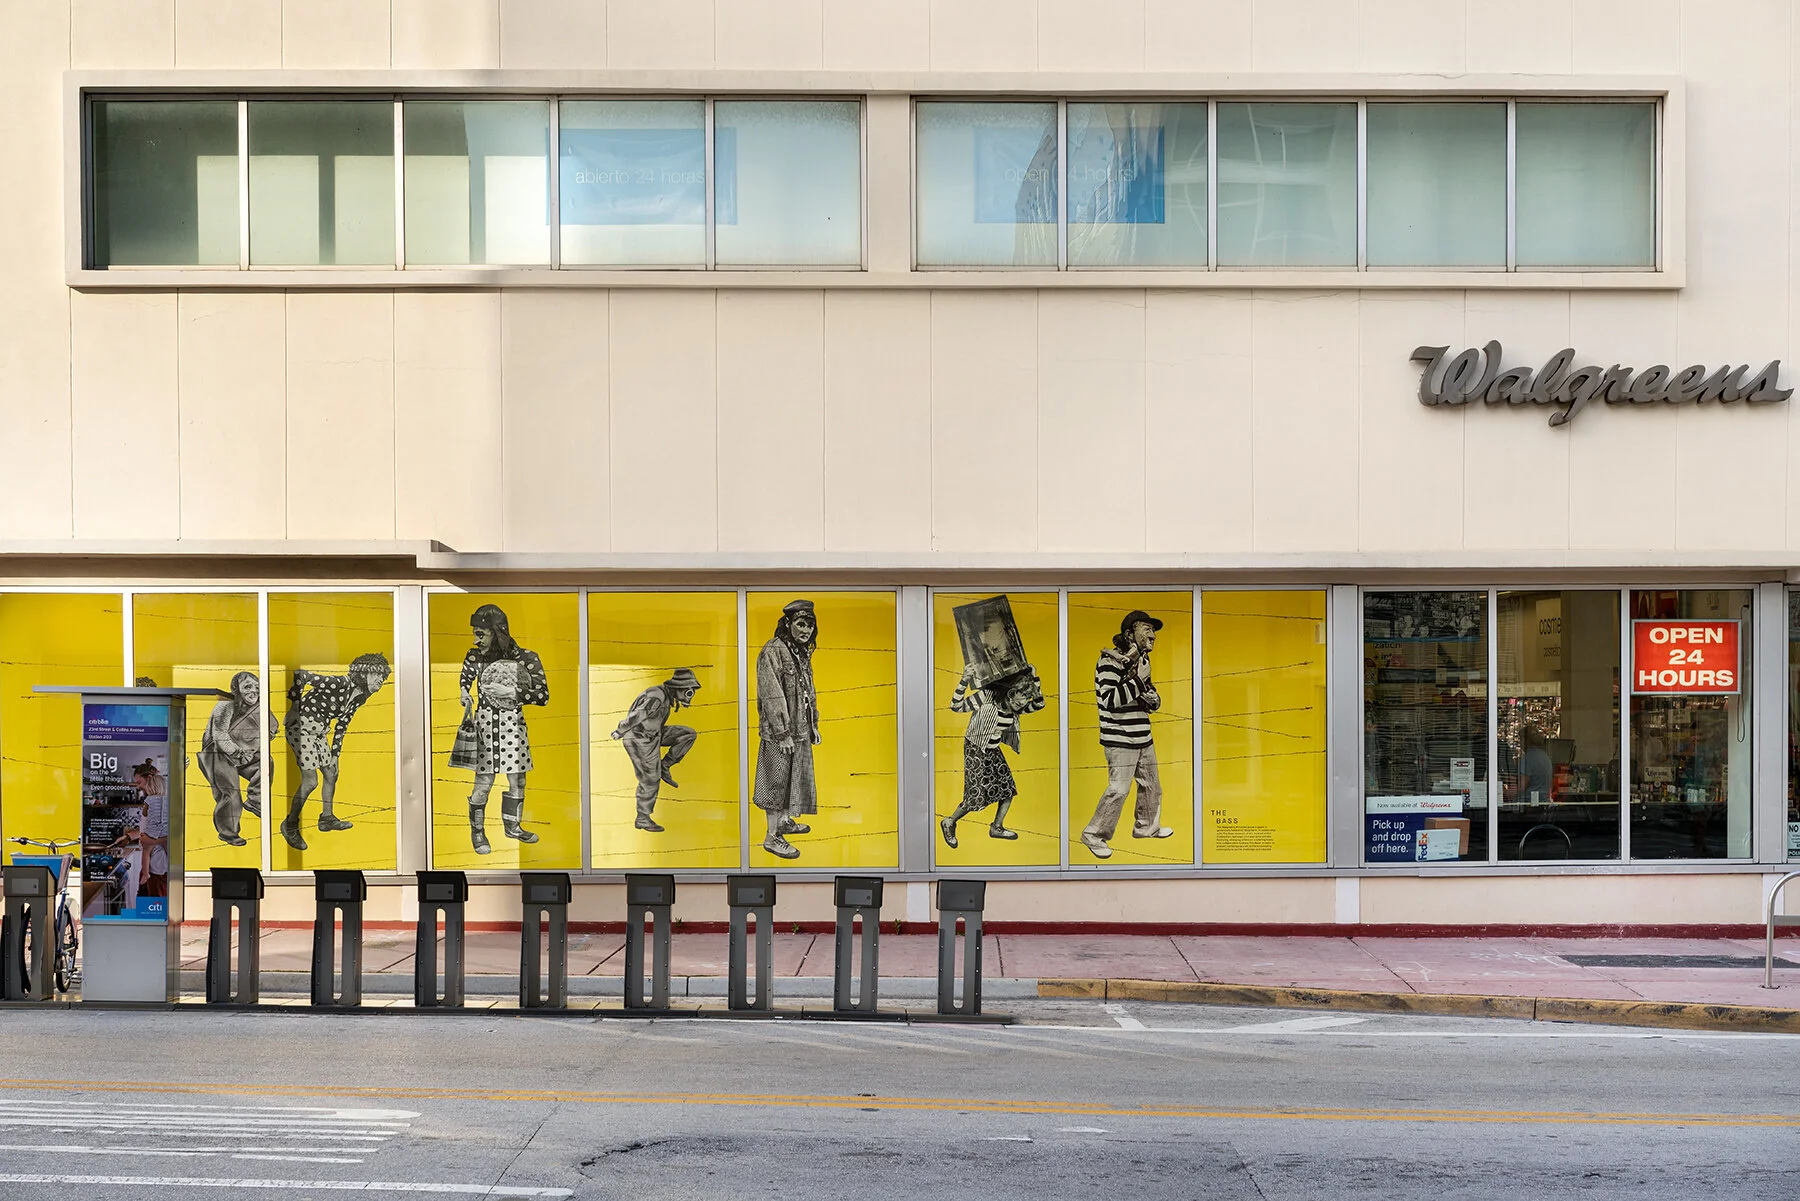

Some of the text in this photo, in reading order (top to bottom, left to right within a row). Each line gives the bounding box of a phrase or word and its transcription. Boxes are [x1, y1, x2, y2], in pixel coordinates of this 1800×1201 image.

[575, 167, 705, 184] abierto 24 horas
[1004, 167, 1050, 186] open
[1408, 339, 1795, 427] Walgreens
[1649, 627, 1724, 644] OPEN
[1668, 649, 1705, 665] 24
[1638, 669, 1734, 686] HOURS
[90, 752, 118, 773] Big
[1420, 801, 1451, 809] Walgreens
[1372, 819, 1405, 831] Pick up
[1788, 824, 1799, 833] NO
[1372, 832, 1411, 843] and drop
[1371, 843, 1409, 853] off here.
[1418, 832, 1428, 860] FedEx
[148, 902, 163, 911] citi
